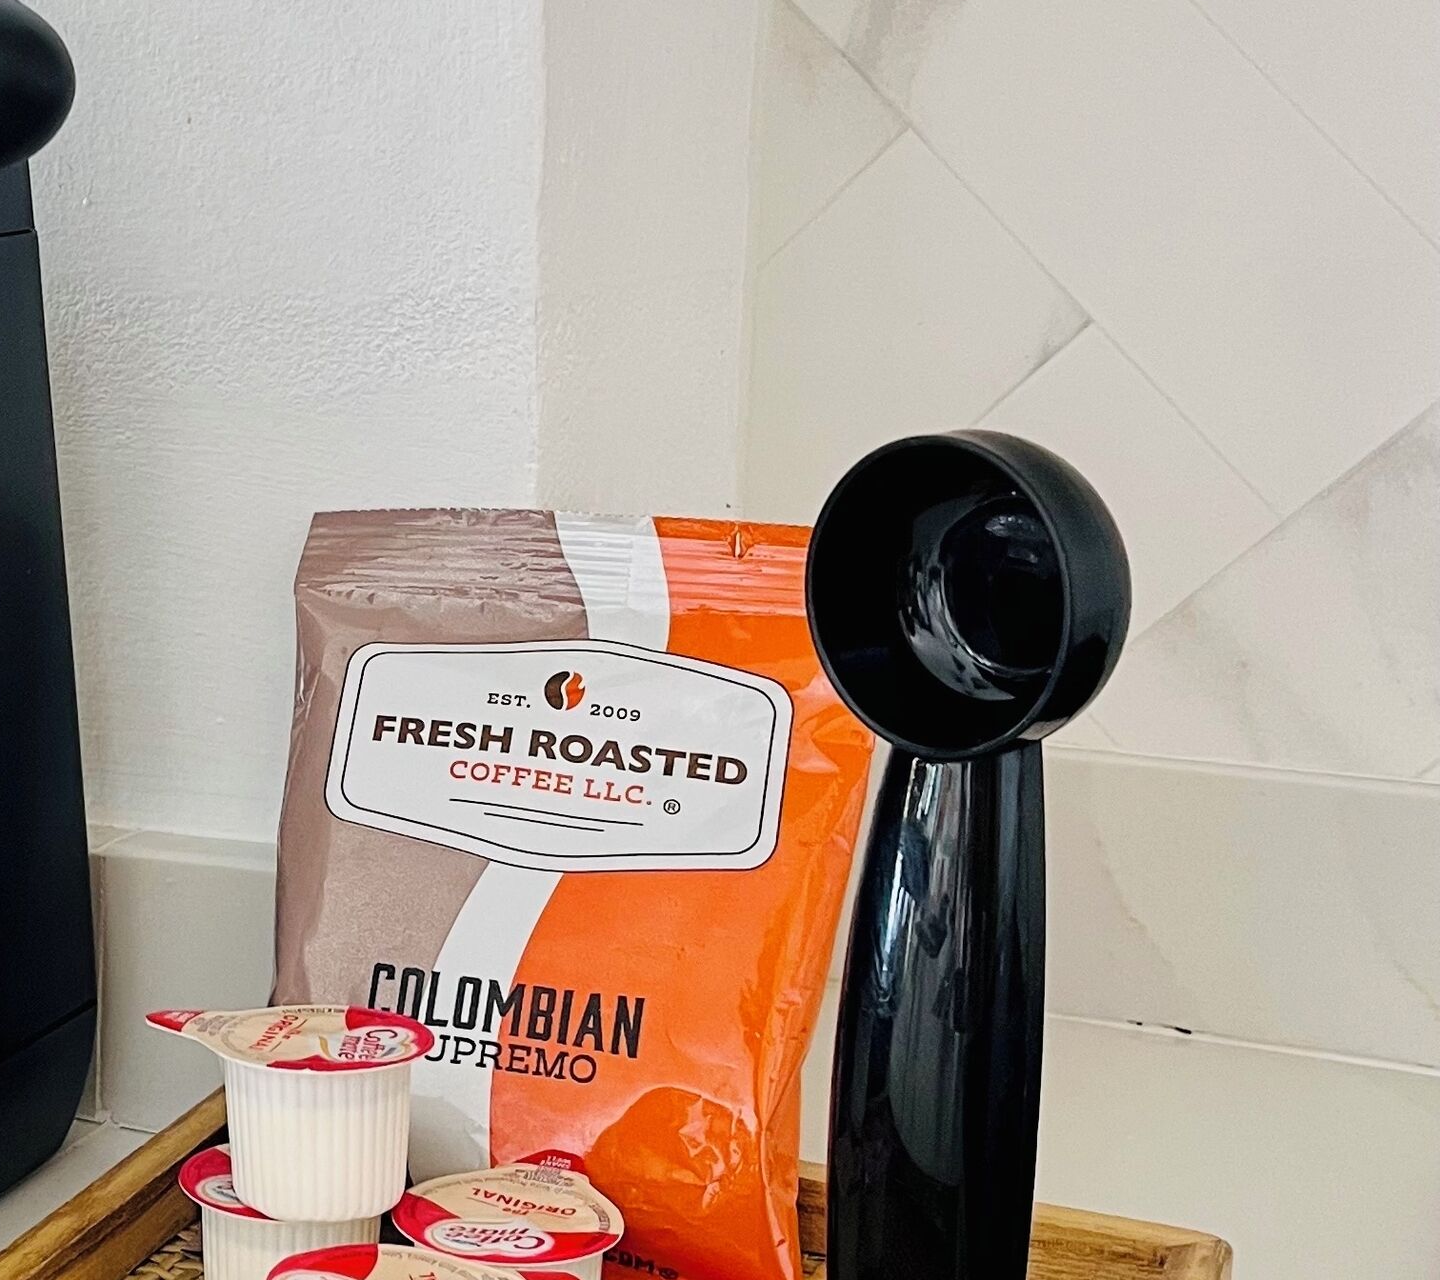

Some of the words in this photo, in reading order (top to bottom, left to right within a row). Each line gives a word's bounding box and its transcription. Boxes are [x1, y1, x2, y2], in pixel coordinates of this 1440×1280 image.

[487, 692, 531, 709] EST.
[590, 704, 641, 722] 2009
[371, 715, 513, 754] FRESH
[528, 729, 748, 786] ROASTED
[449, 760, 574, 795] COFFEE
[583, 778, 652, 806] LLC.
[368, 962, 646, 1059] COLOMBIAN
[424, 1034, 598, 1084] UPREMO
[472, 1187, 577, 1216] ORIGINAL
